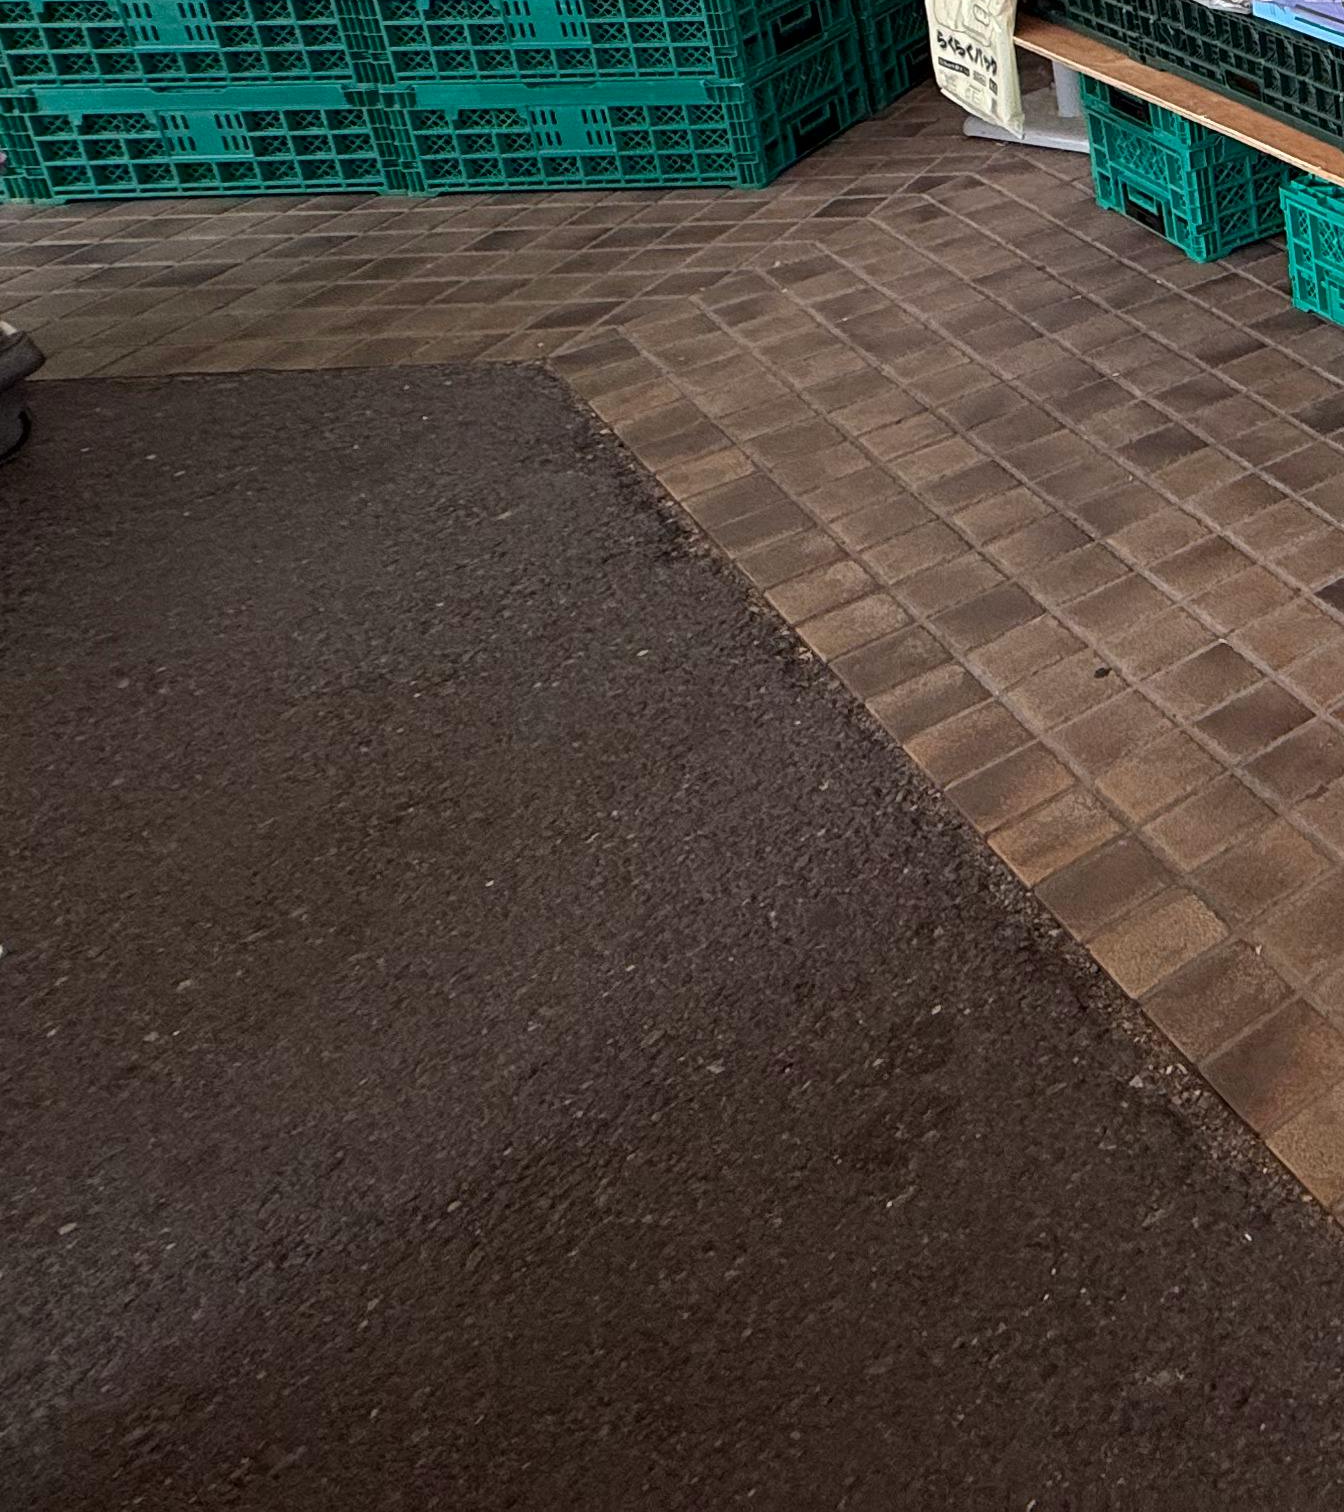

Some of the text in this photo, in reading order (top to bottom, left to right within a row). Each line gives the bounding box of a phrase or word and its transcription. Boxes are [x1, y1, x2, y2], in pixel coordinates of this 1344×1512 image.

[936, 29, 998, 77] らくらくパック
